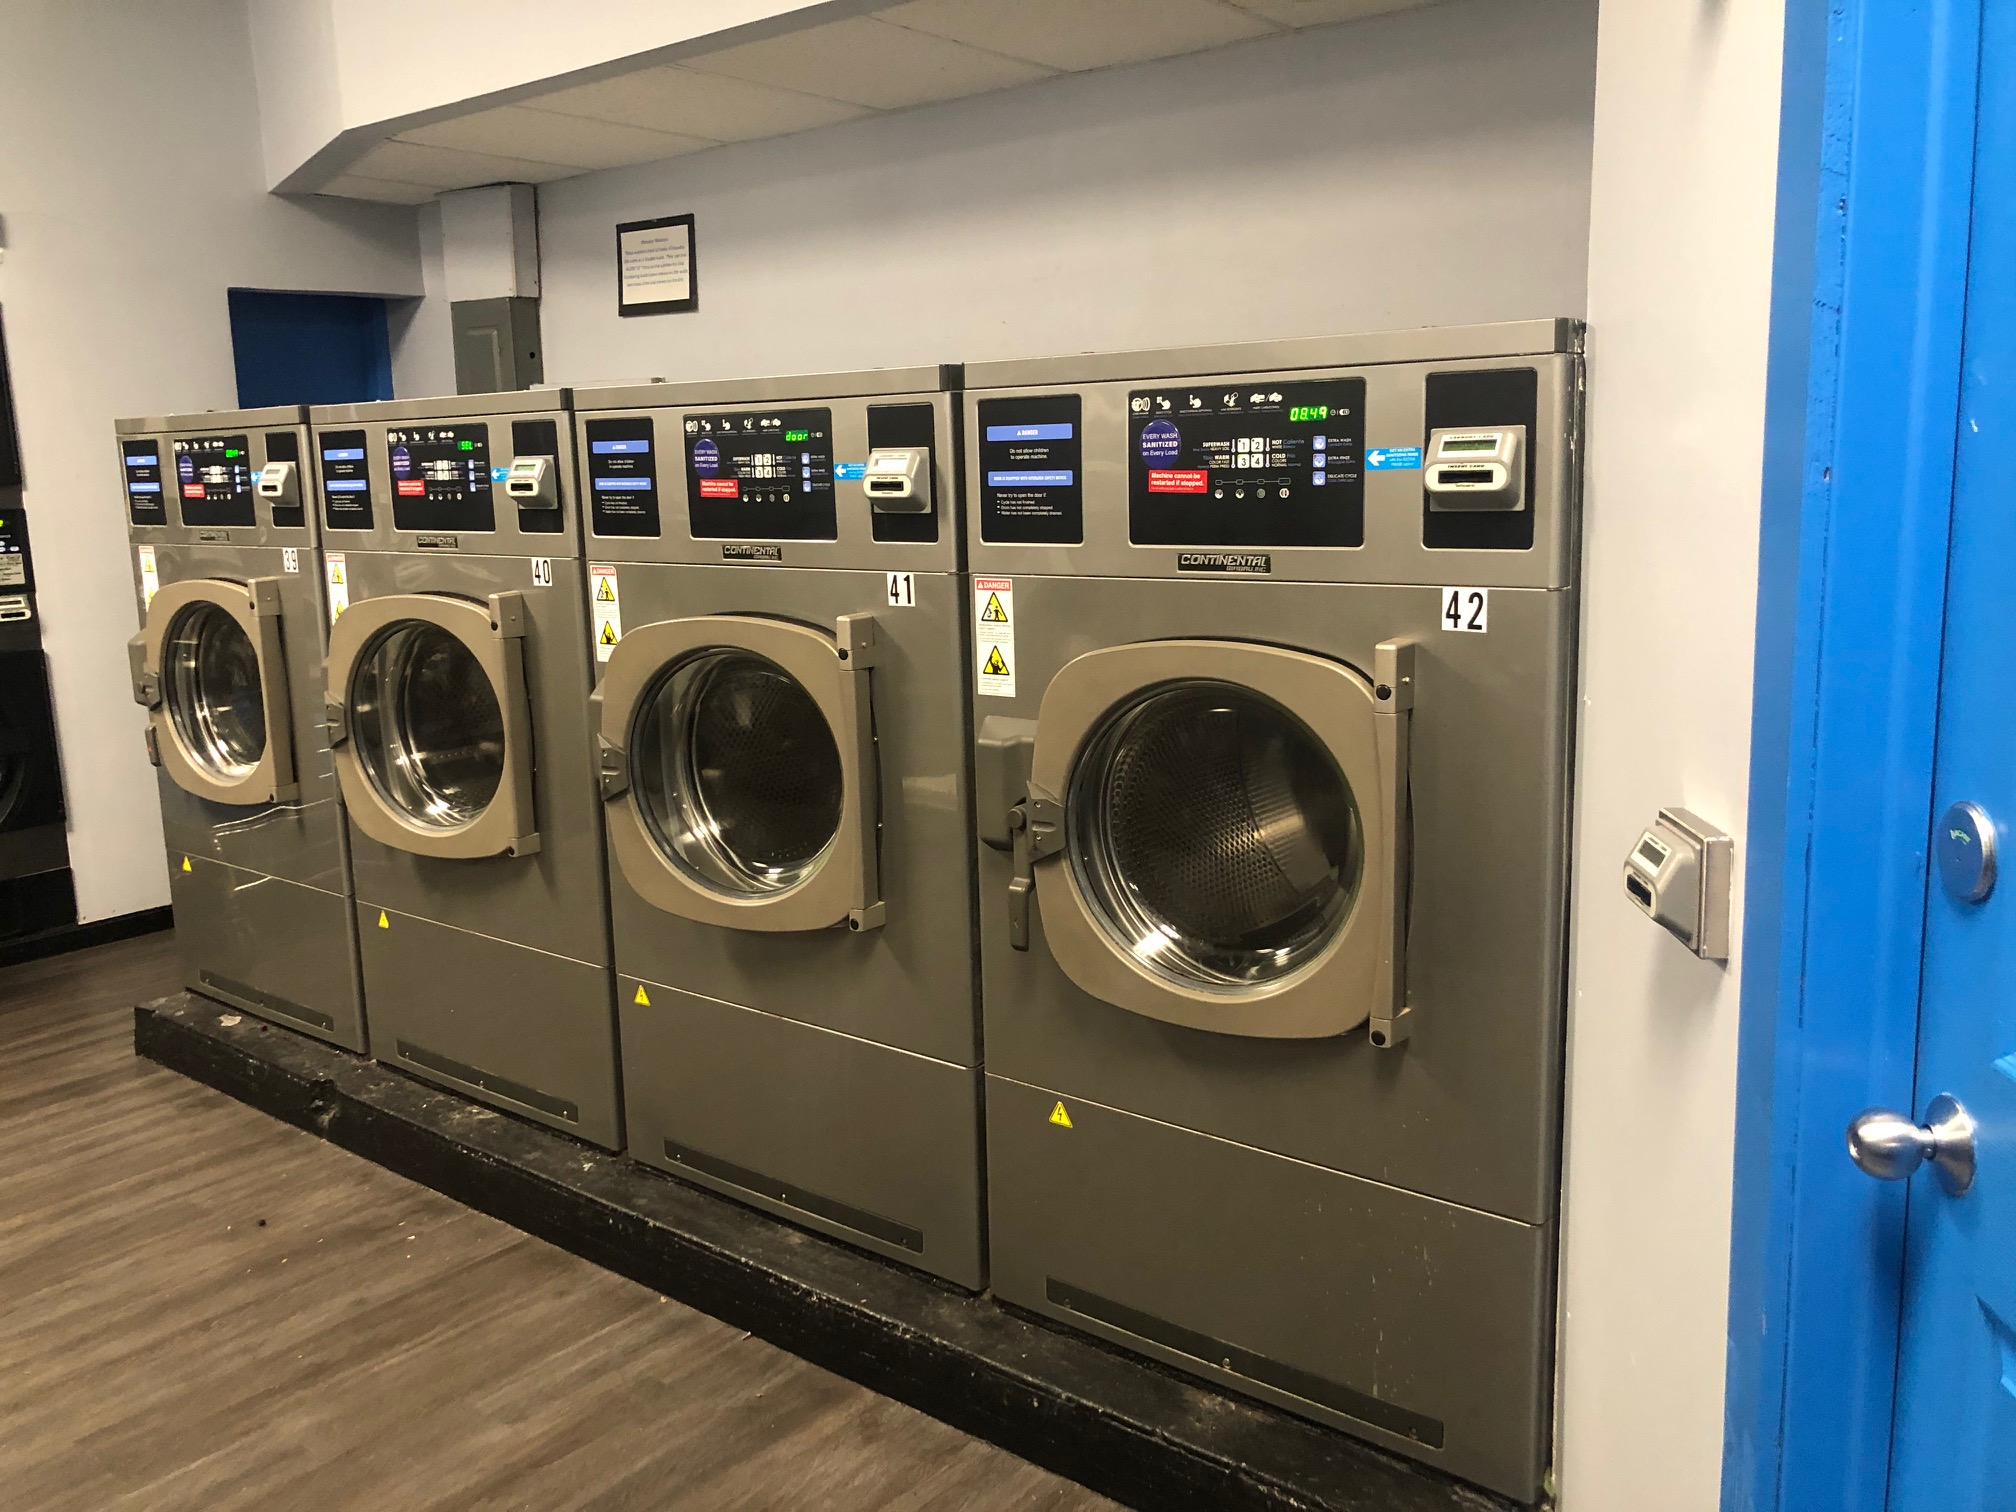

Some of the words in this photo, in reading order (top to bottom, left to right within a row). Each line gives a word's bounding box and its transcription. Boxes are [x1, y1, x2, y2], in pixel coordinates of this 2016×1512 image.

[1180, 480, 1204, 488] stopped.
[285, 550, 297, 570] 39
[724, 545, 780, 556] CONTINENTAL
[1181, 554, 1266, 567] CONTINENTAL
[534, 559, 551, 584] 40
[890, 574, 912, 605] 41
[1445, 590, 1484, 630] 42
